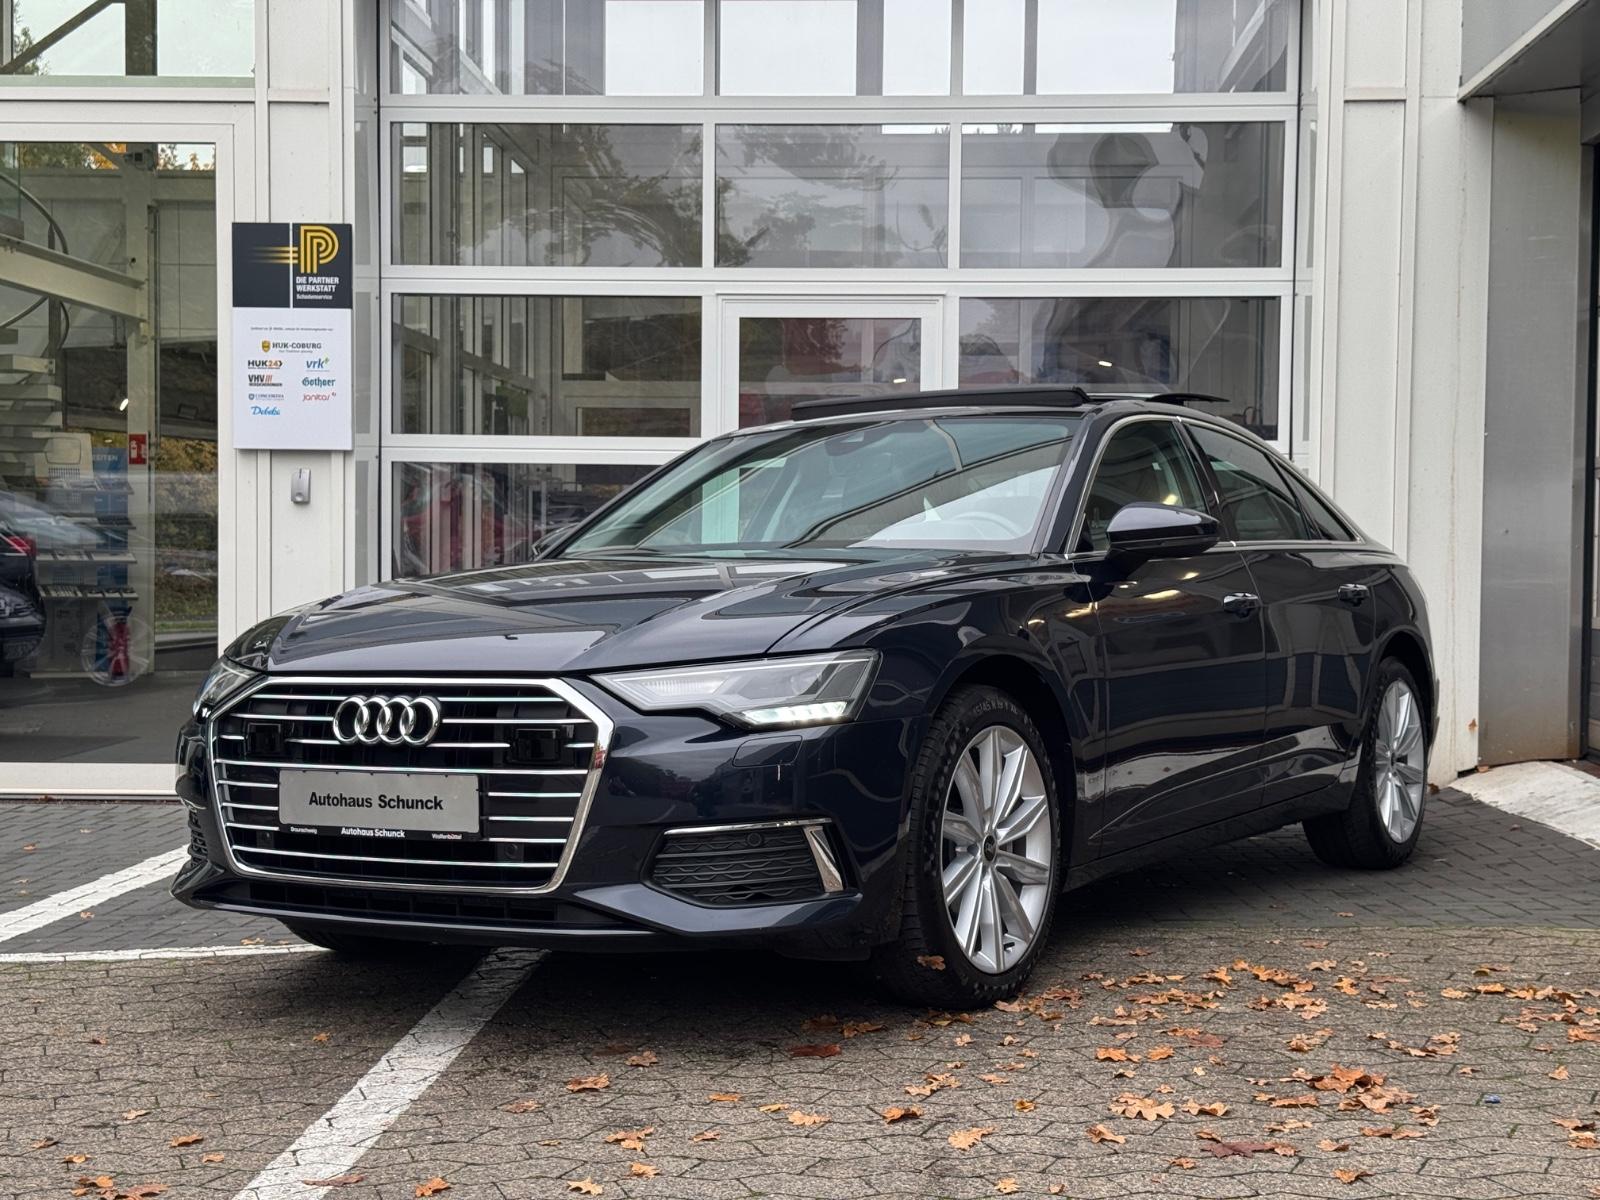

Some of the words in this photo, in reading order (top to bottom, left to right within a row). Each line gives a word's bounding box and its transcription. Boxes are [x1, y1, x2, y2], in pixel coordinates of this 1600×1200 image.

[296, 276, 307, 284] DIE
[309, 276, 339, 284] PARTNER
[296, 285, 337, 293] WERKSTATT
[306, 359, 325, 369] vrk
[248, 374, 265, 383] VHV
[302, 377, 336, 388] Gothaer
[309, 791, 373, 808] Autohaus
[378, 794, 444, 810] Schunck
[341, 826, 374, 837] Autohaus
[374, 828, 405, 838] Schunck
